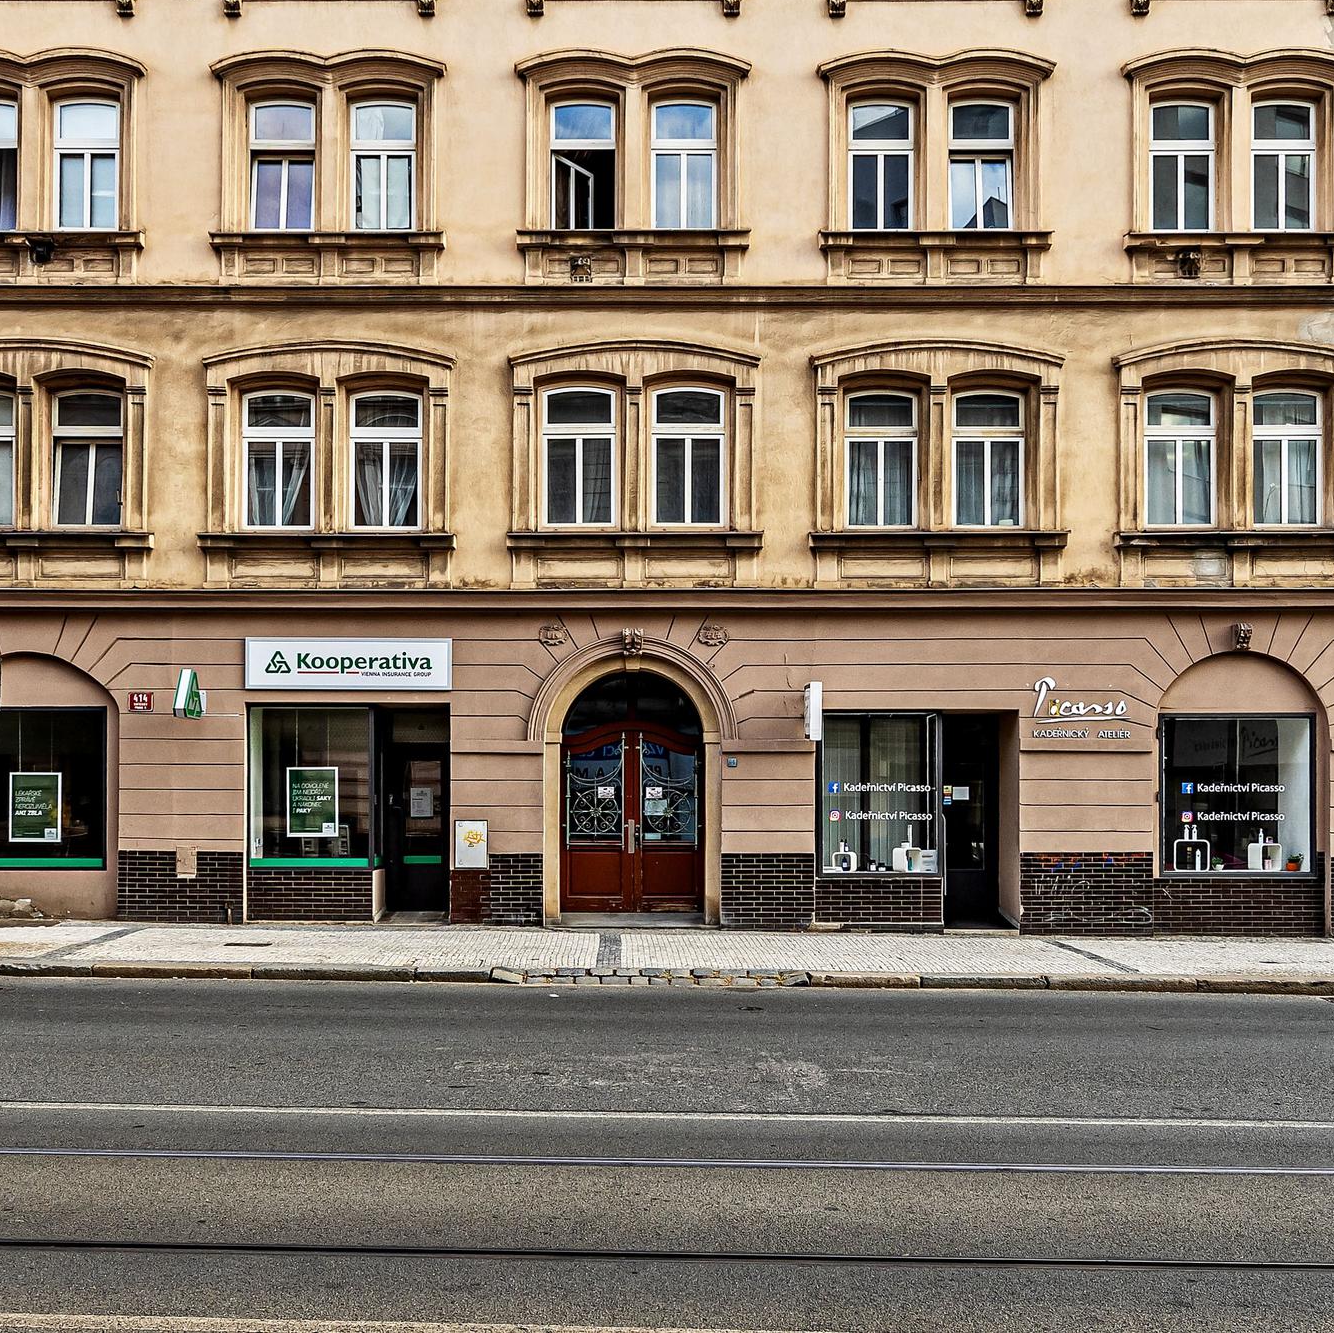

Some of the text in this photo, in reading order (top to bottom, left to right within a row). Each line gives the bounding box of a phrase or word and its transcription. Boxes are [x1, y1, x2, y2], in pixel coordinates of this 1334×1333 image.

[297, 651, 433, 674] Kooperativa
[133, 693, 148, 703] 414
[1033, 676, 1128, 718] Picasso
[1033, 727, 1131, 739] KADEŘNICKÝ ATELIÉR
[843, 782, 931, 793] Kadeřnictví Picasso
[1197, 782, 1285, 793] Kadeřnictví Picasso
[845, 810, 933, 821] Kadeřnictví Picasso
[1197, 811, 1285, 821] Kadeřnictví Picasso
